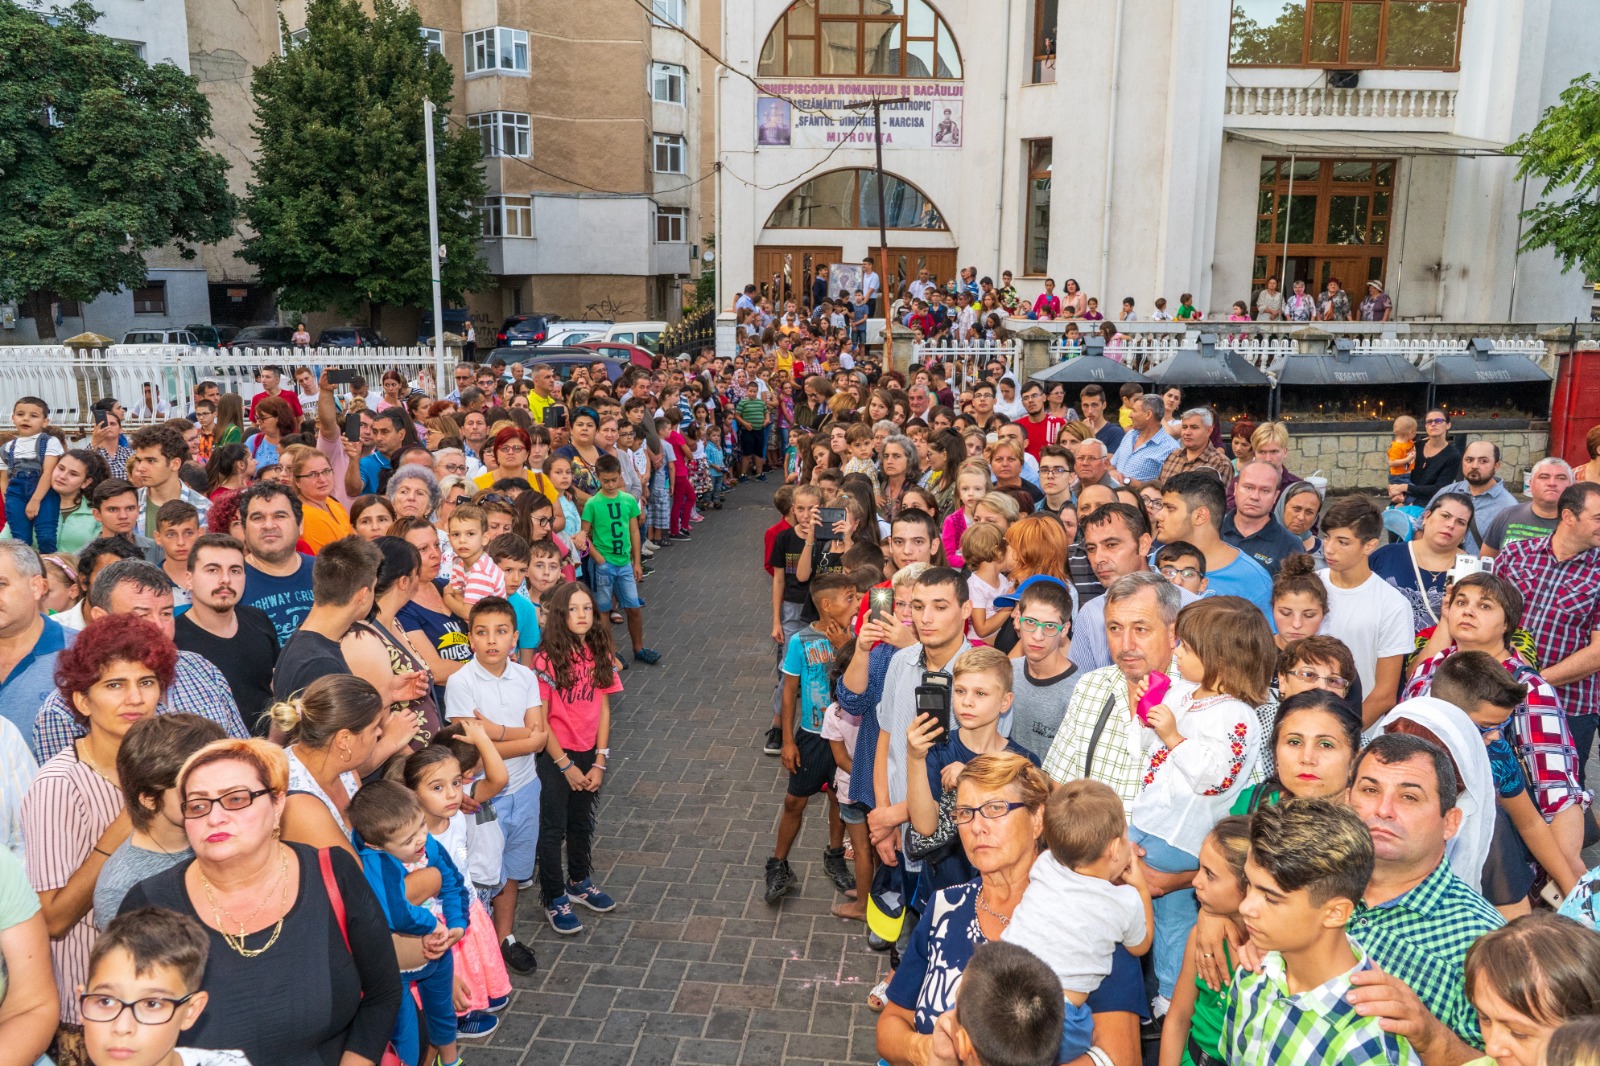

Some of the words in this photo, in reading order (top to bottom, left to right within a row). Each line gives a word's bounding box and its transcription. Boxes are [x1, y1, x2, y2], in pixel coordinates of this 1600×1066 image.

[838, 84, 898, 96] ROMANULUI
[913, 83, 963, 97] BACĂULUI
[889, 117, 925, 127] NARCISA
